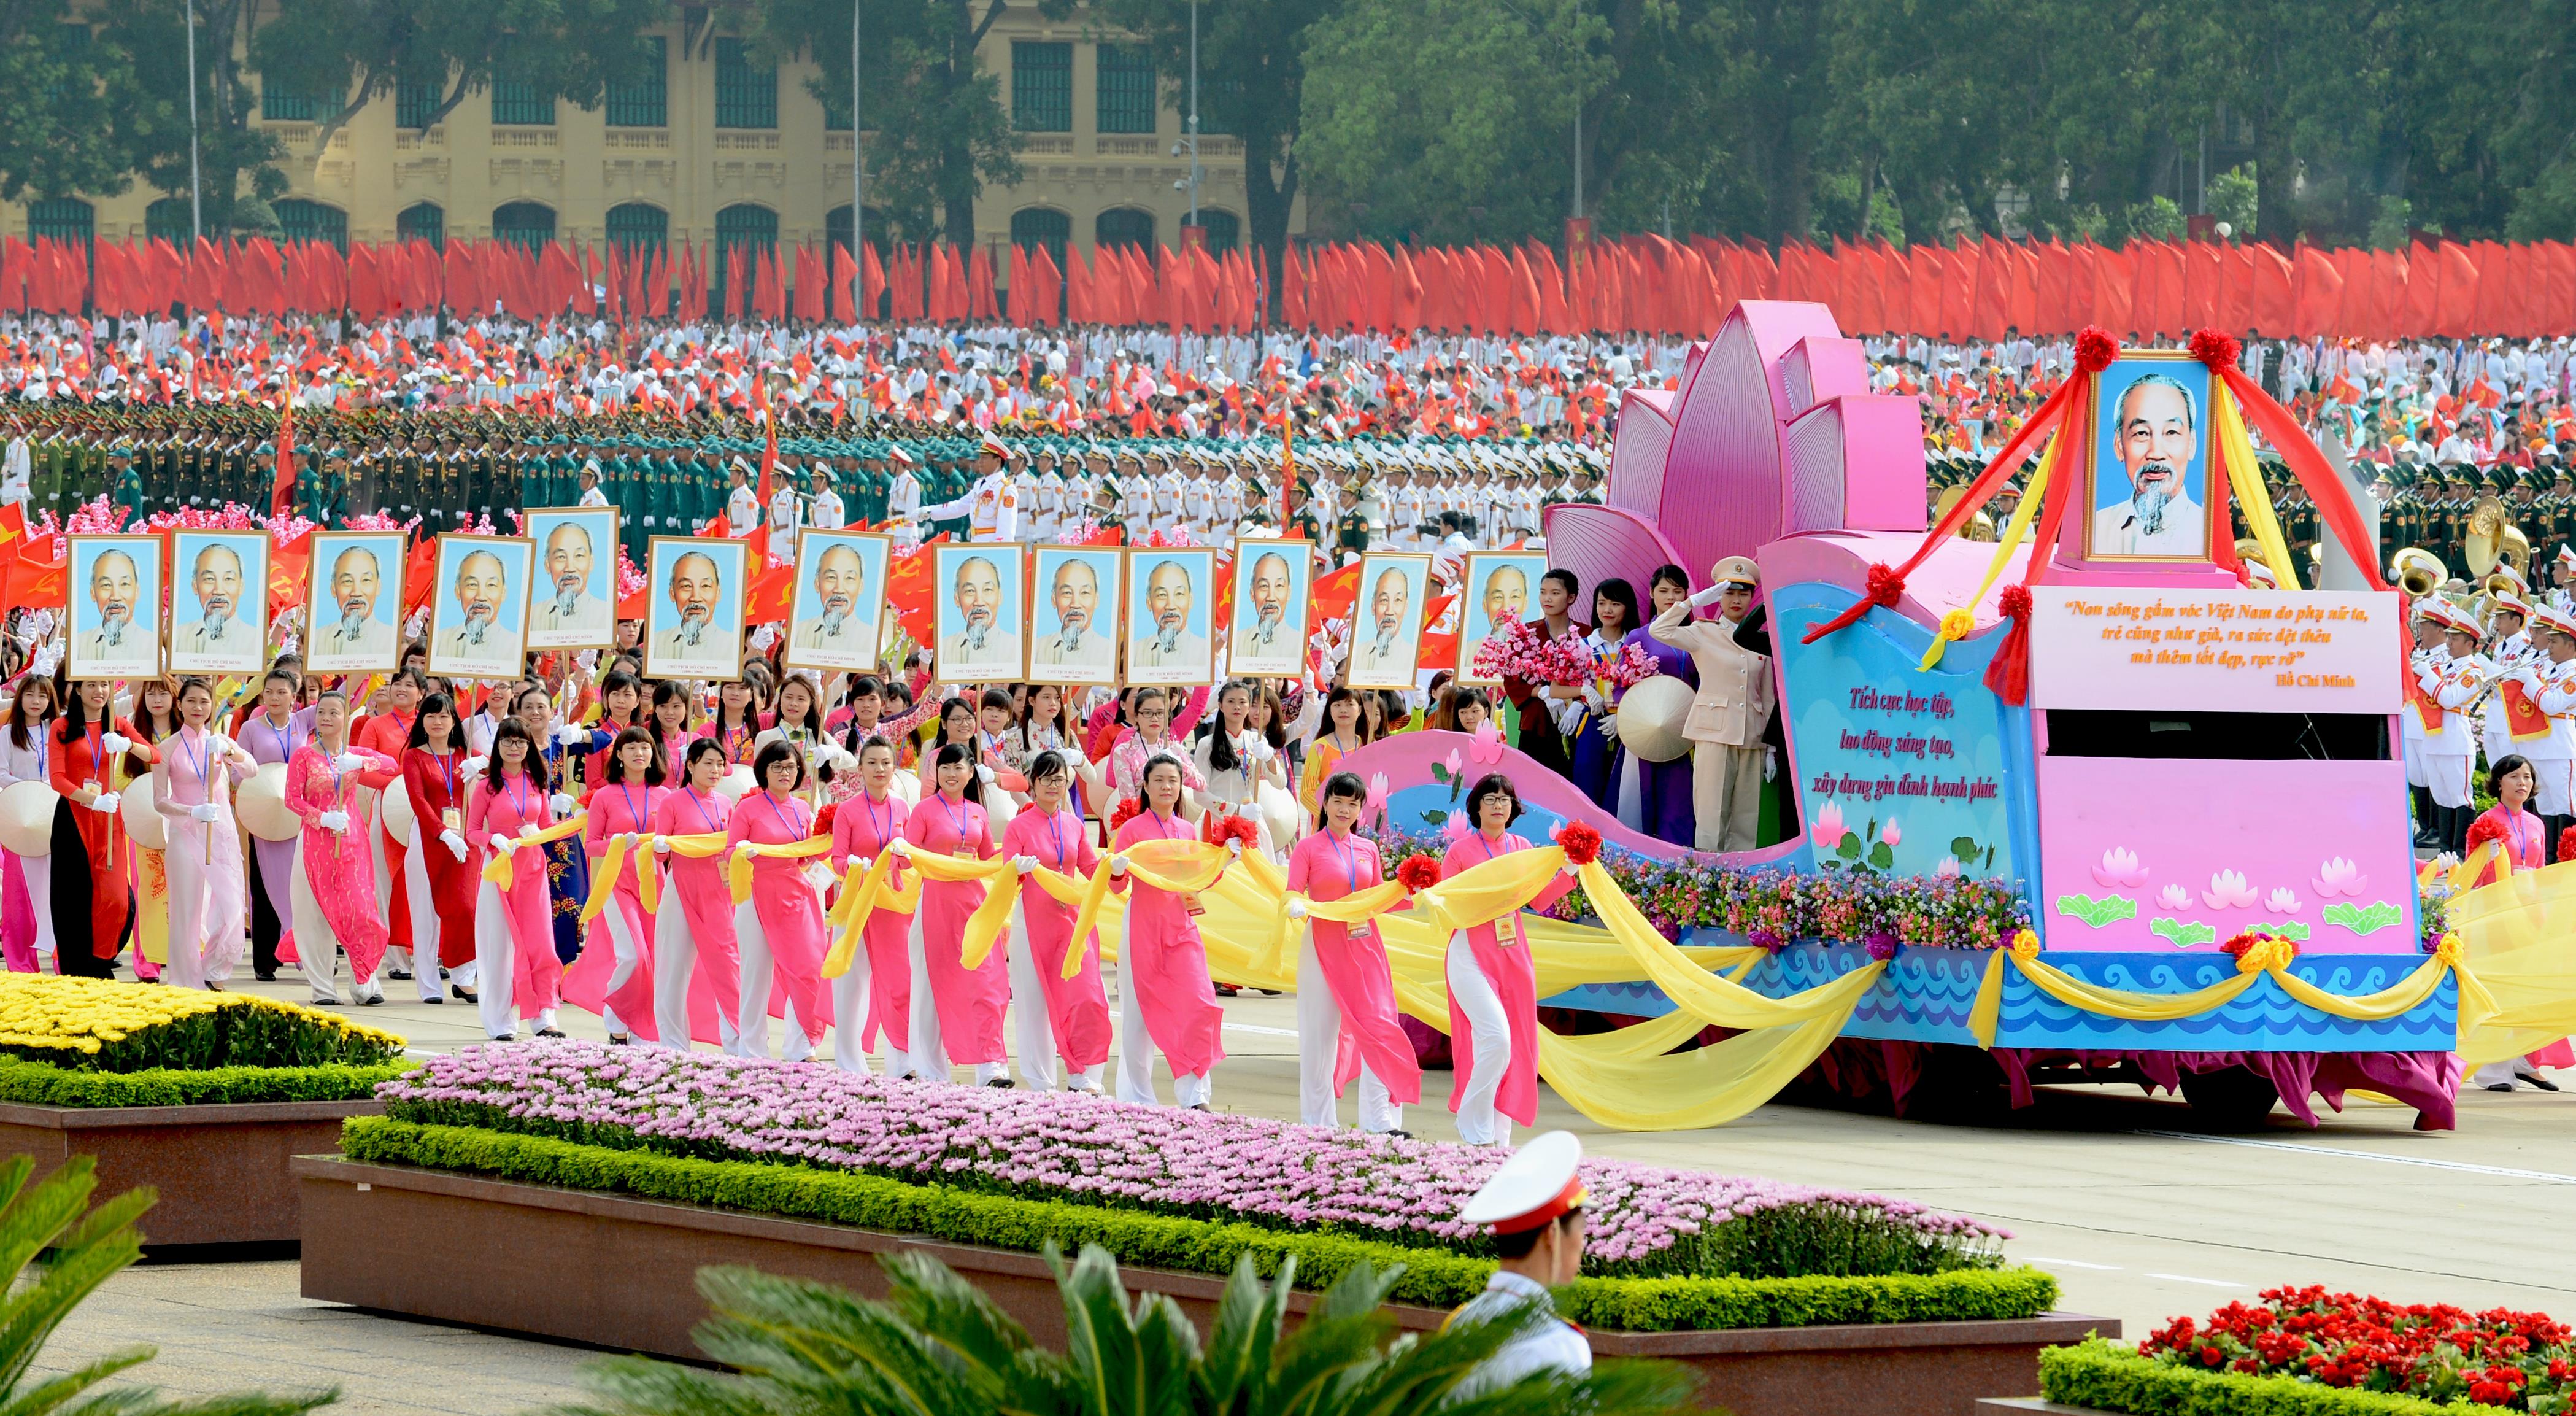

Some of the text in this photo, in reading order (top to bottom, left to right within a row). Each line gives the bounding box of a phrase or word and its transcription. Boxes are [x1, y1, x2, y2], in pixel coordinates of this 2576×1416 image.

[2107, 601, 2141, 621] sông
[2143, 598, 2175, 621] gấm
[2180, 603, 2203, 617] vóc
[2208, 603, 2236, 622] Việt
[2239, 604, 2273, 619] Nam
[2275, 605, 2294, 619] do
[2294, 604, 2326, 624] phụ
[2328, 605, 2350, 620] nữ
[2351, 608, 2369, 622] ta,
[2125, 625, 2161, 644] cũng
[2165, 625, 2195, 640] như
[2197, 627, 2224, 645] già,
[2228, 630, 2244, 642] ra
[2248, 628, 2272, 643] sức
[2275, 628, 2297, 646] dệt
[2300, 629, 2332, 643] thêu
[2131, 648, 2154, 664] mà
[2156, 649, 2192, 664] thêm
[2196, 645, 2216, 665] tốt
[2218, 649, 2247, 670] đẹp,
[2251, 654, 2277, 668] rực
[2297, 674, 2320, 687] Chí
[2323, 674, 2356, 687] Minh
[1850, 686, 1954, 719] Tích cực học tập,
[1840, 729, 1954, 760] lao động sáng tạo,
[1812, 772, 1997, 804] xây dựng gia đình hạnh phúc
